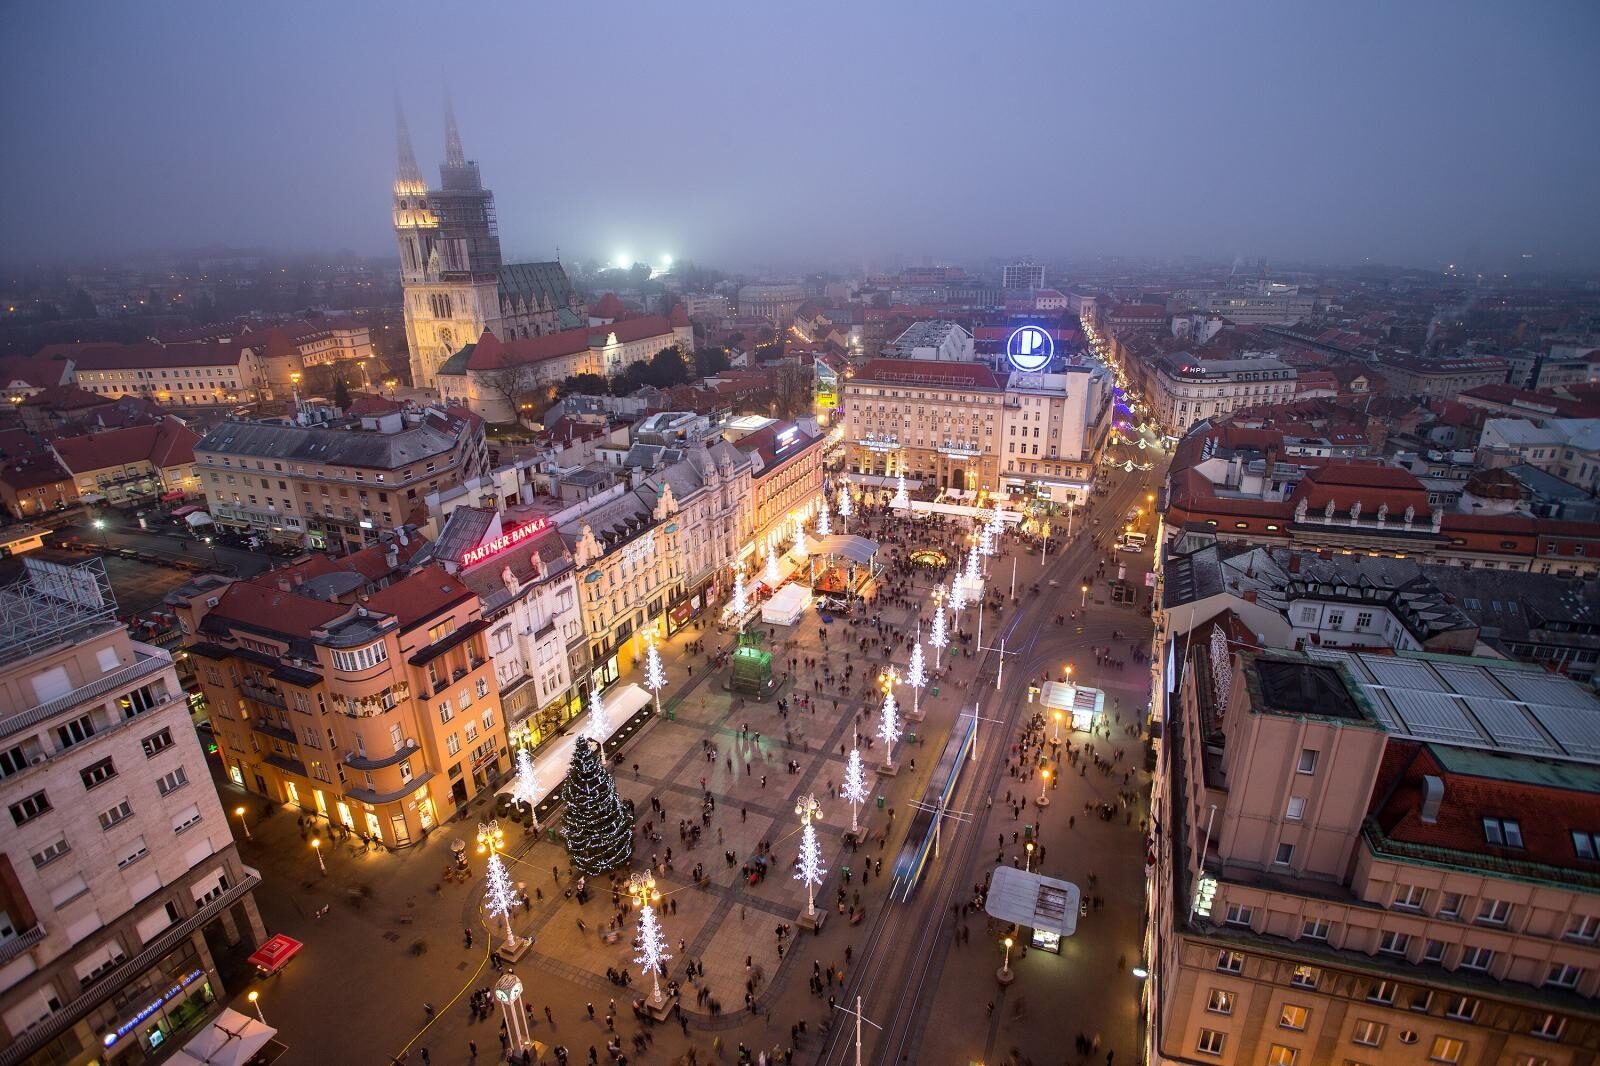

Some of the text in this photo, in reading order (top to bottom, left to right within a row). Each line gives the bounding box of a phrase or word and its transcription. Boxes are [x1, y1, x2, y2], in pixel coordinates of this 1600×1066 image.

[859, 410, 904, 421] GRADSKA
[463, 518, 546, 566] PARTNER BANKA
